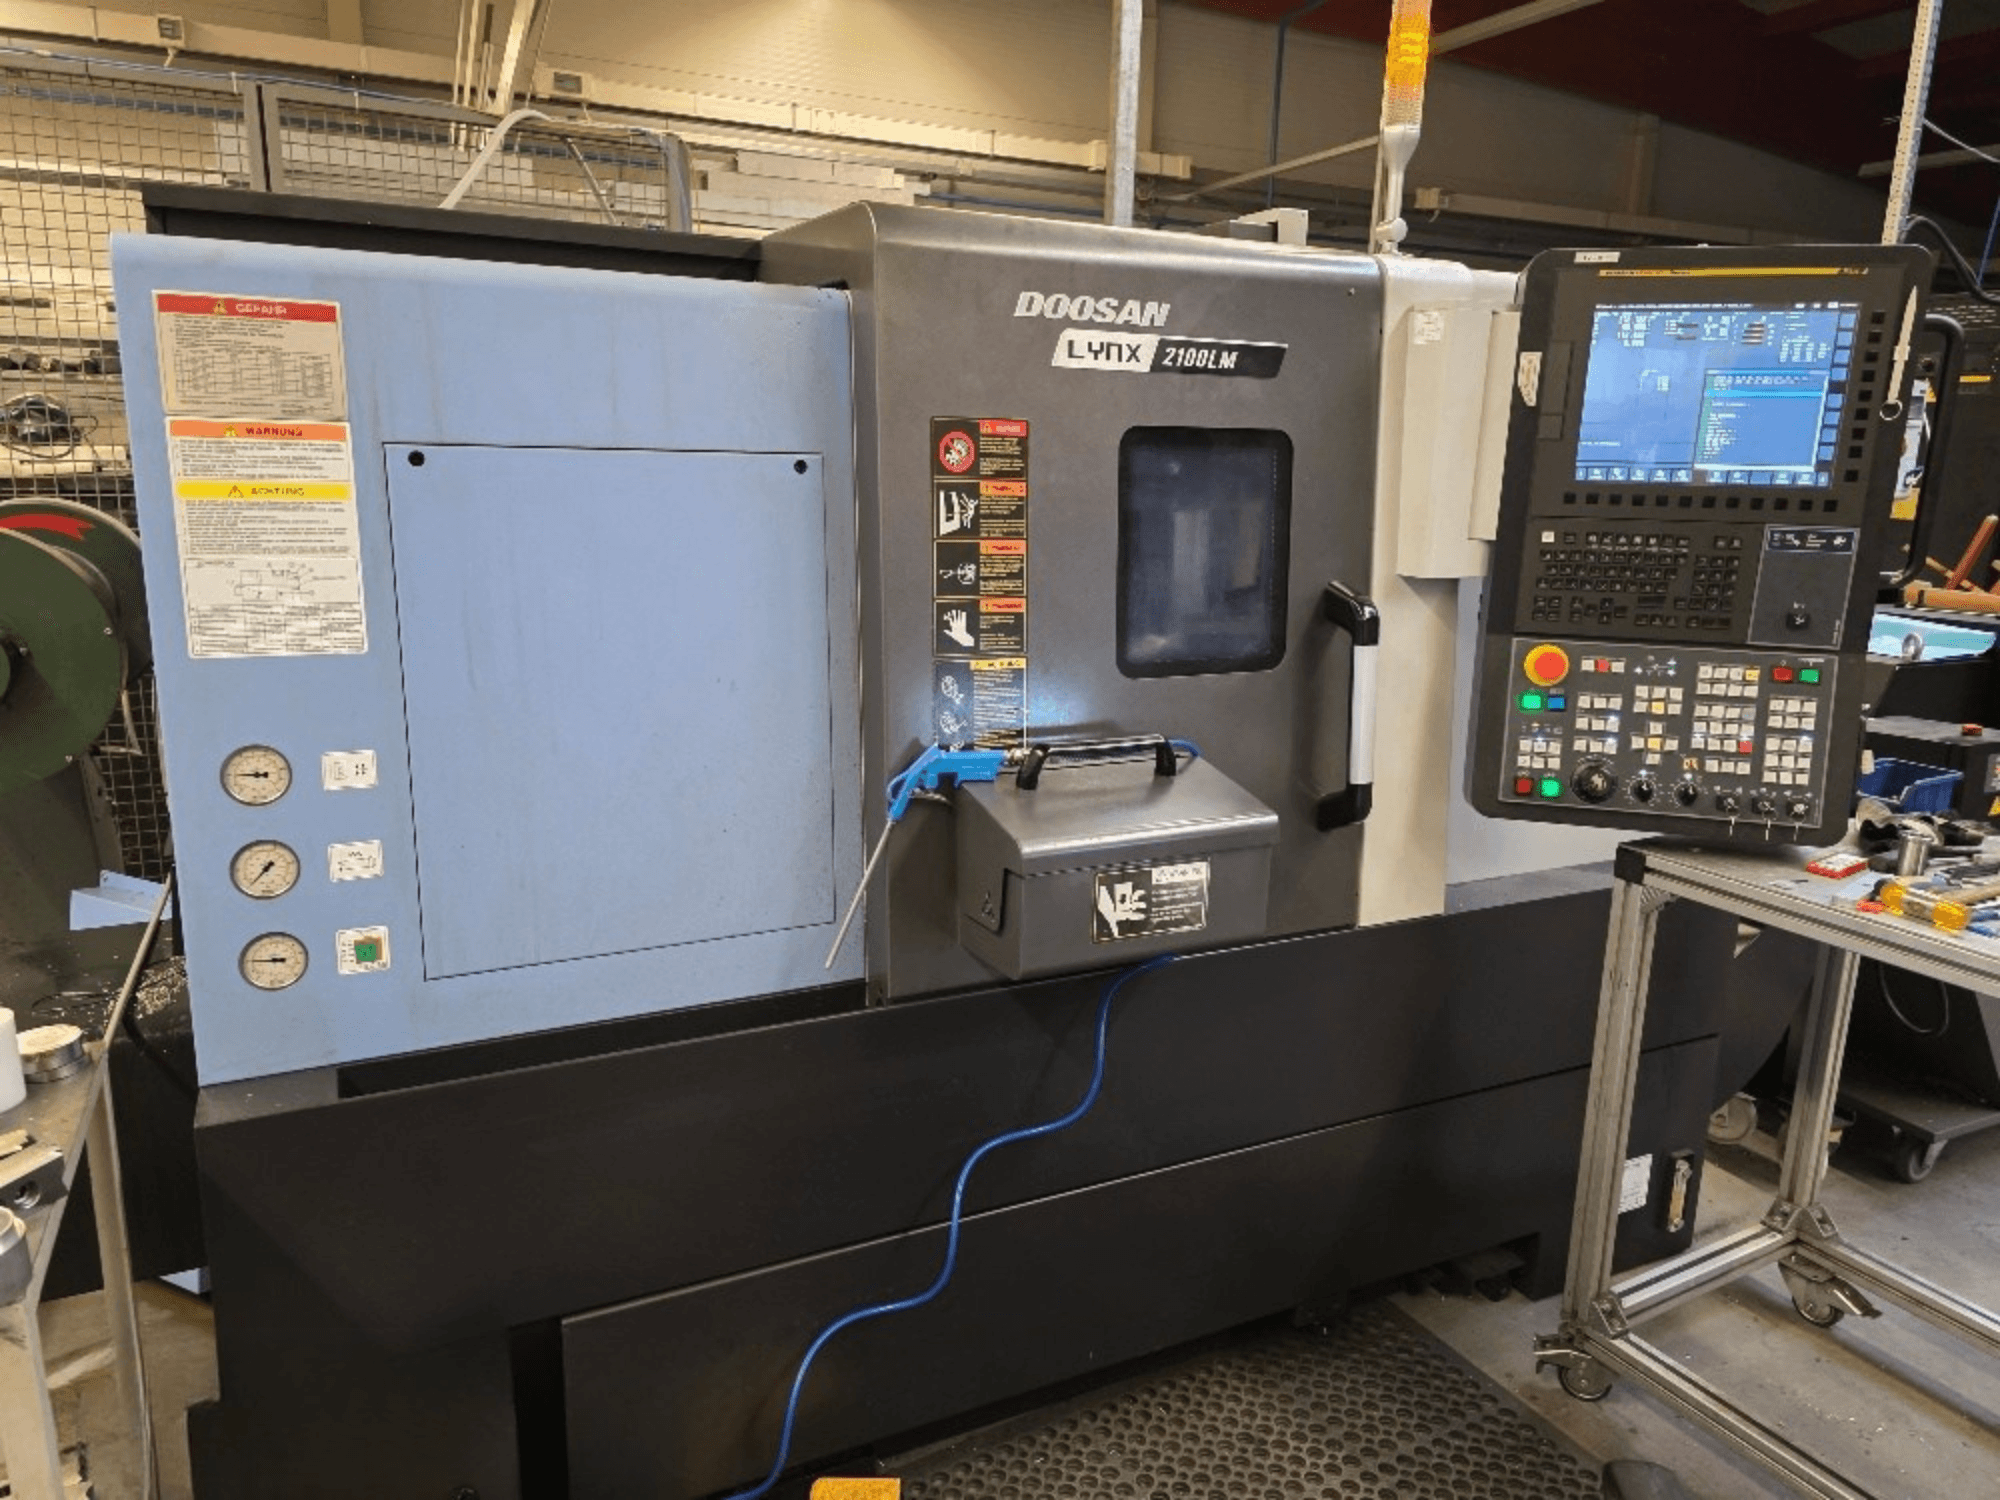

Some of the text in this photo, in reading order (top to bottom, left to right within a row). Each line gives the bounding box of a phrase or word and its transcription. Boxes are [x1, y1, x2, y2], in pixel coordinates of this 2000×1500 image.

[1013, 291, 1171, 327] DOOSAN
[1067, 339, 1239, 370] LYNX 2100LM
